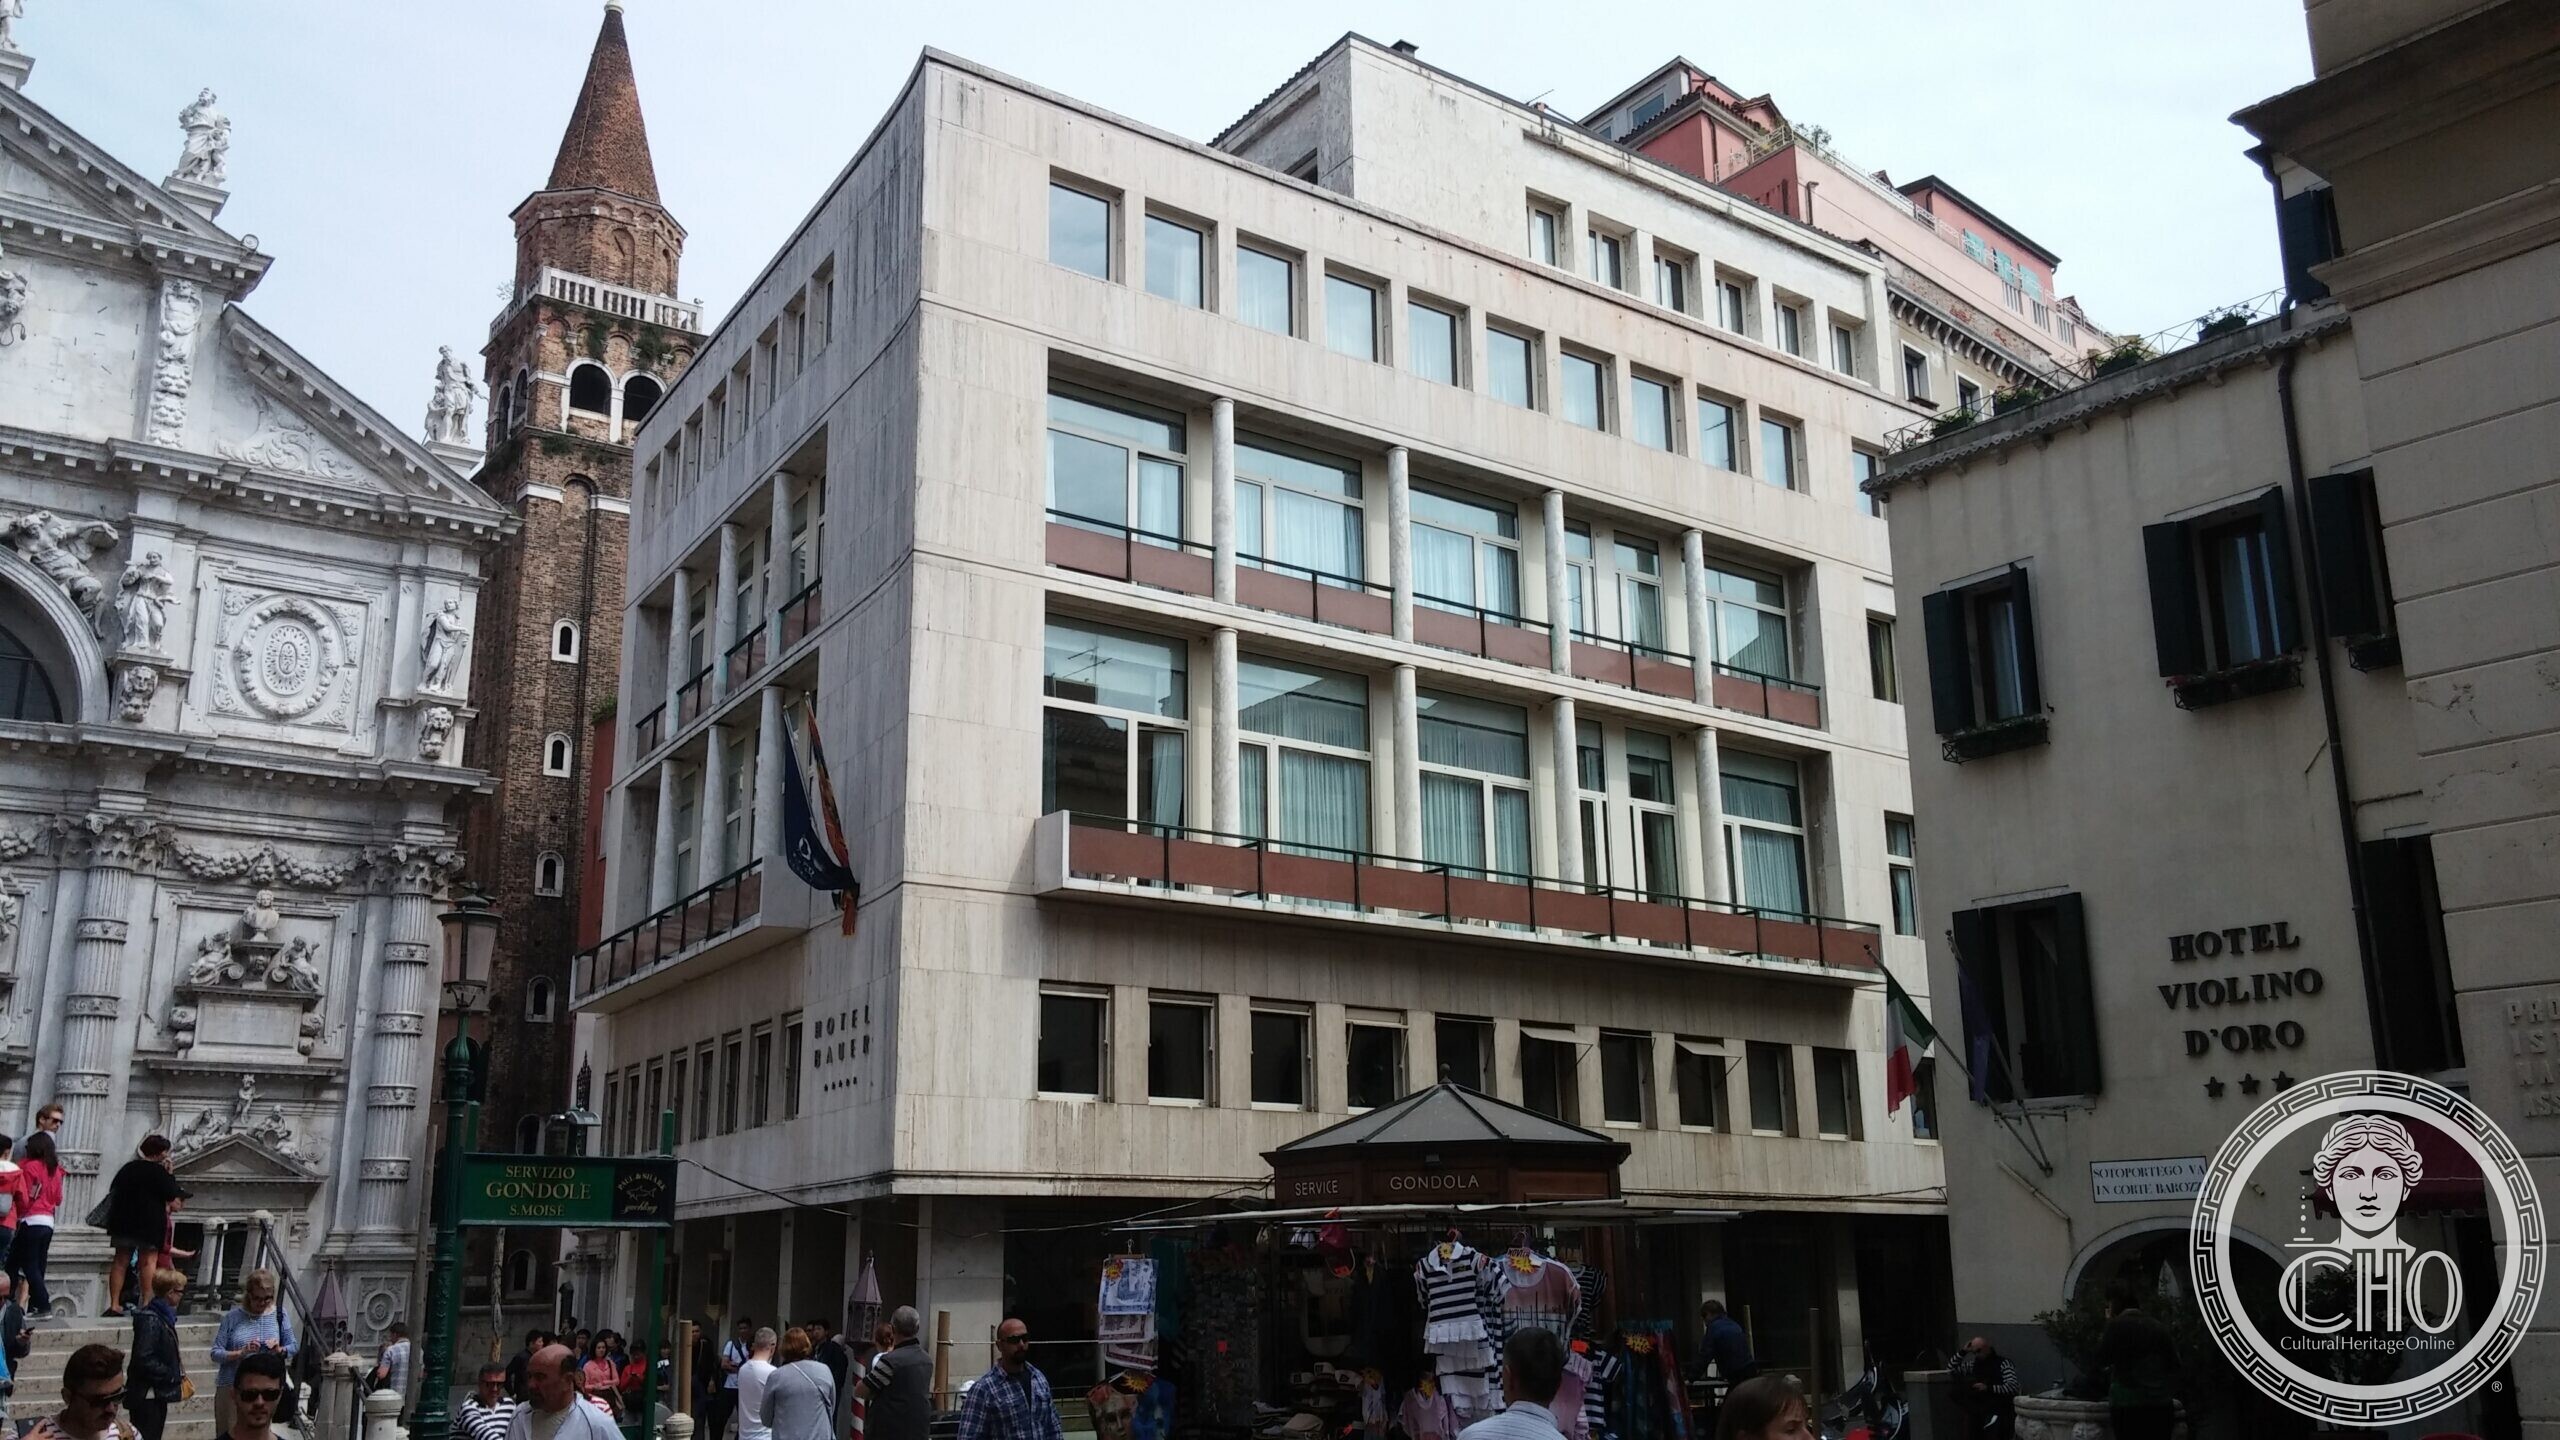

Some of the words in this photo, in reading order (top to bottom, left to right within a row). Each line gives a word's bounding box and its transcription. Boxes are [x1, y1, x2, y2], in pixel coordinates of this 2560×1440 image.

[2168, 922, 2300, 961] HOTEL
[2157, 968, 2323, 1010] VIOLINO
[814, 1005, 870, 1039] HOTEL
[2183, 1020, 2305, 1056] D'ORO
[814, 1035, 870, 1069] BAUER
[506, 1165, 575, 1179] SERVIZIO
[2093, 1165, 2183, 1178] SOTOPORTEGO
[486, 1181, 592, 1200] GONDOLE
[1295, 1180, 1338, 1196] SERVICE
[1389, 1174, 1479, 1190] GONDOLA
[2096, 1185, 2110, 1196] IN
[2113, 1183, 2152, 1195] CORTE
